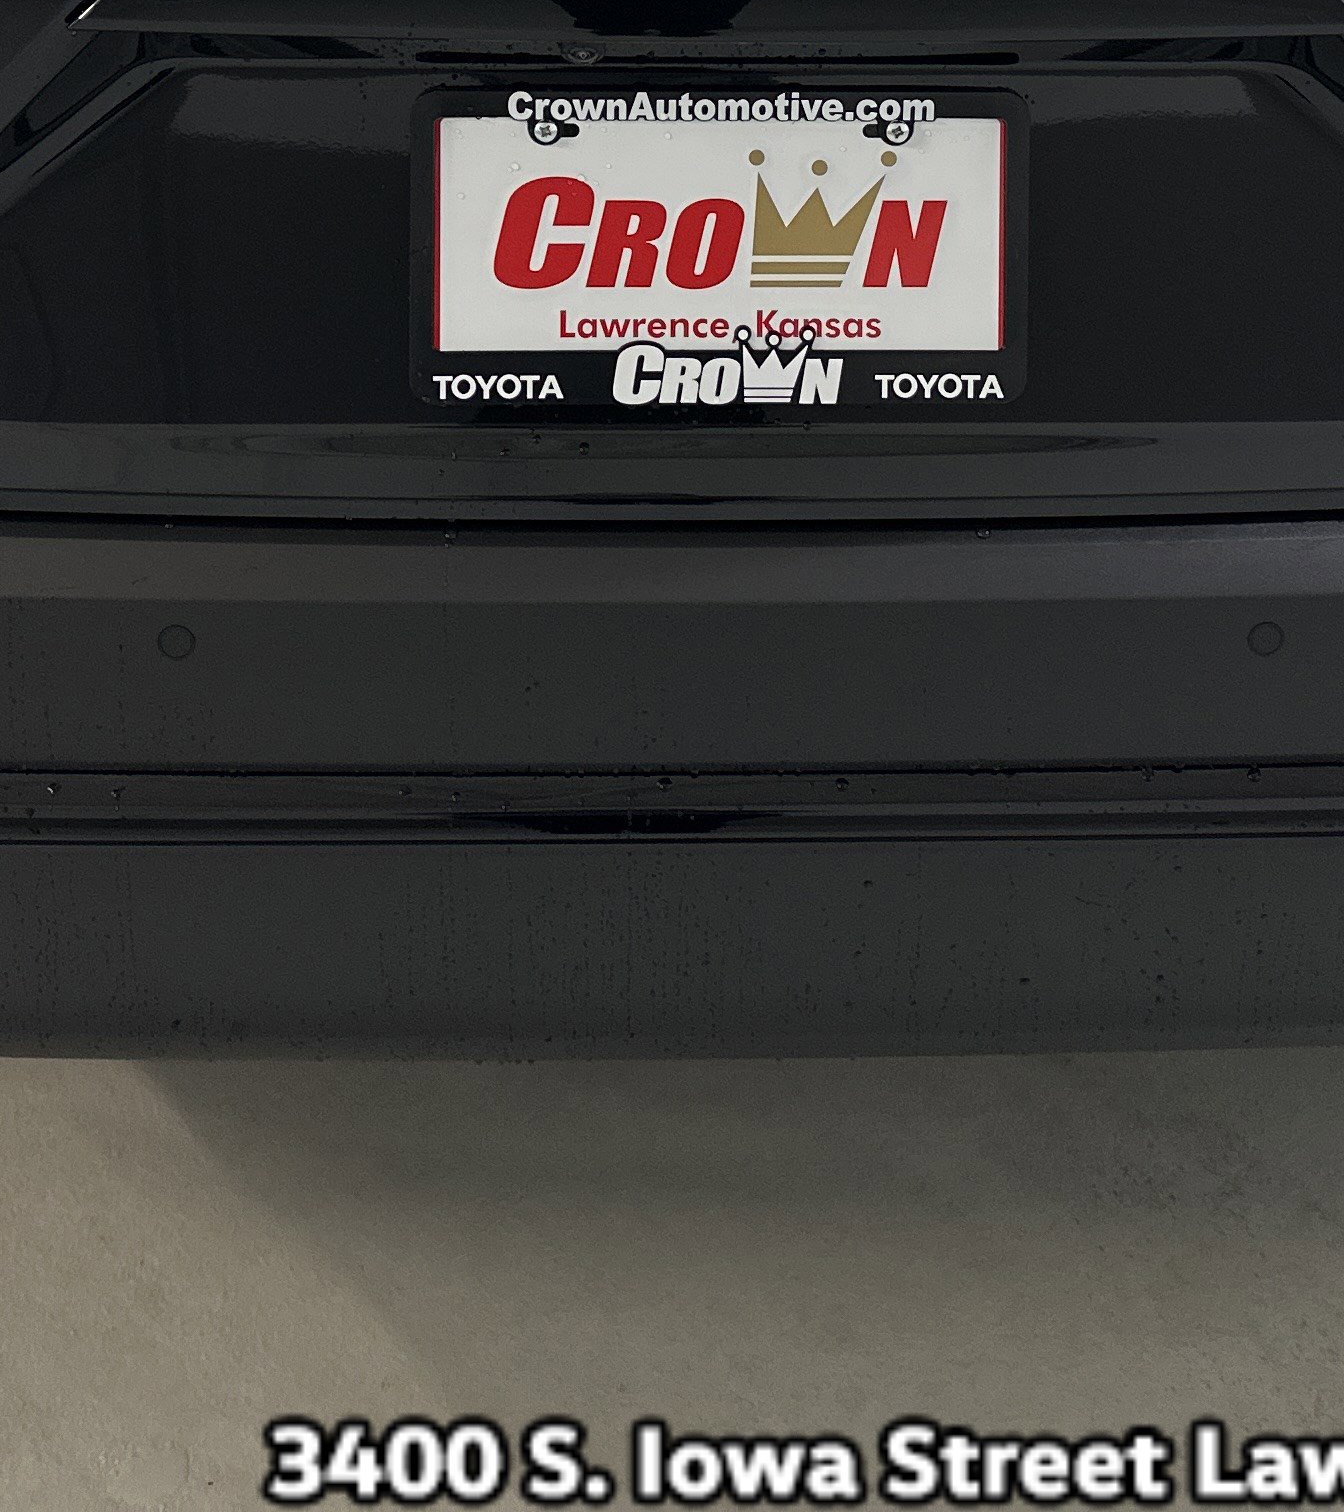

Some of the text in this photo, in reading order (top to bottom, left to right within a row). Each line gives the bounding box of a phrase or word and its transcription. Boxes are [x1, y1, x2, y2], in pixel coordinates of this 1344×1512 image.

[508, 91, 936, 122] CrownAutomotive.com
[559, 310, 882, 343] Lawrence Kansas
[433, 375, 564, 400] TOYOTA
[875, 374, 1005, 399] TOYOTA
